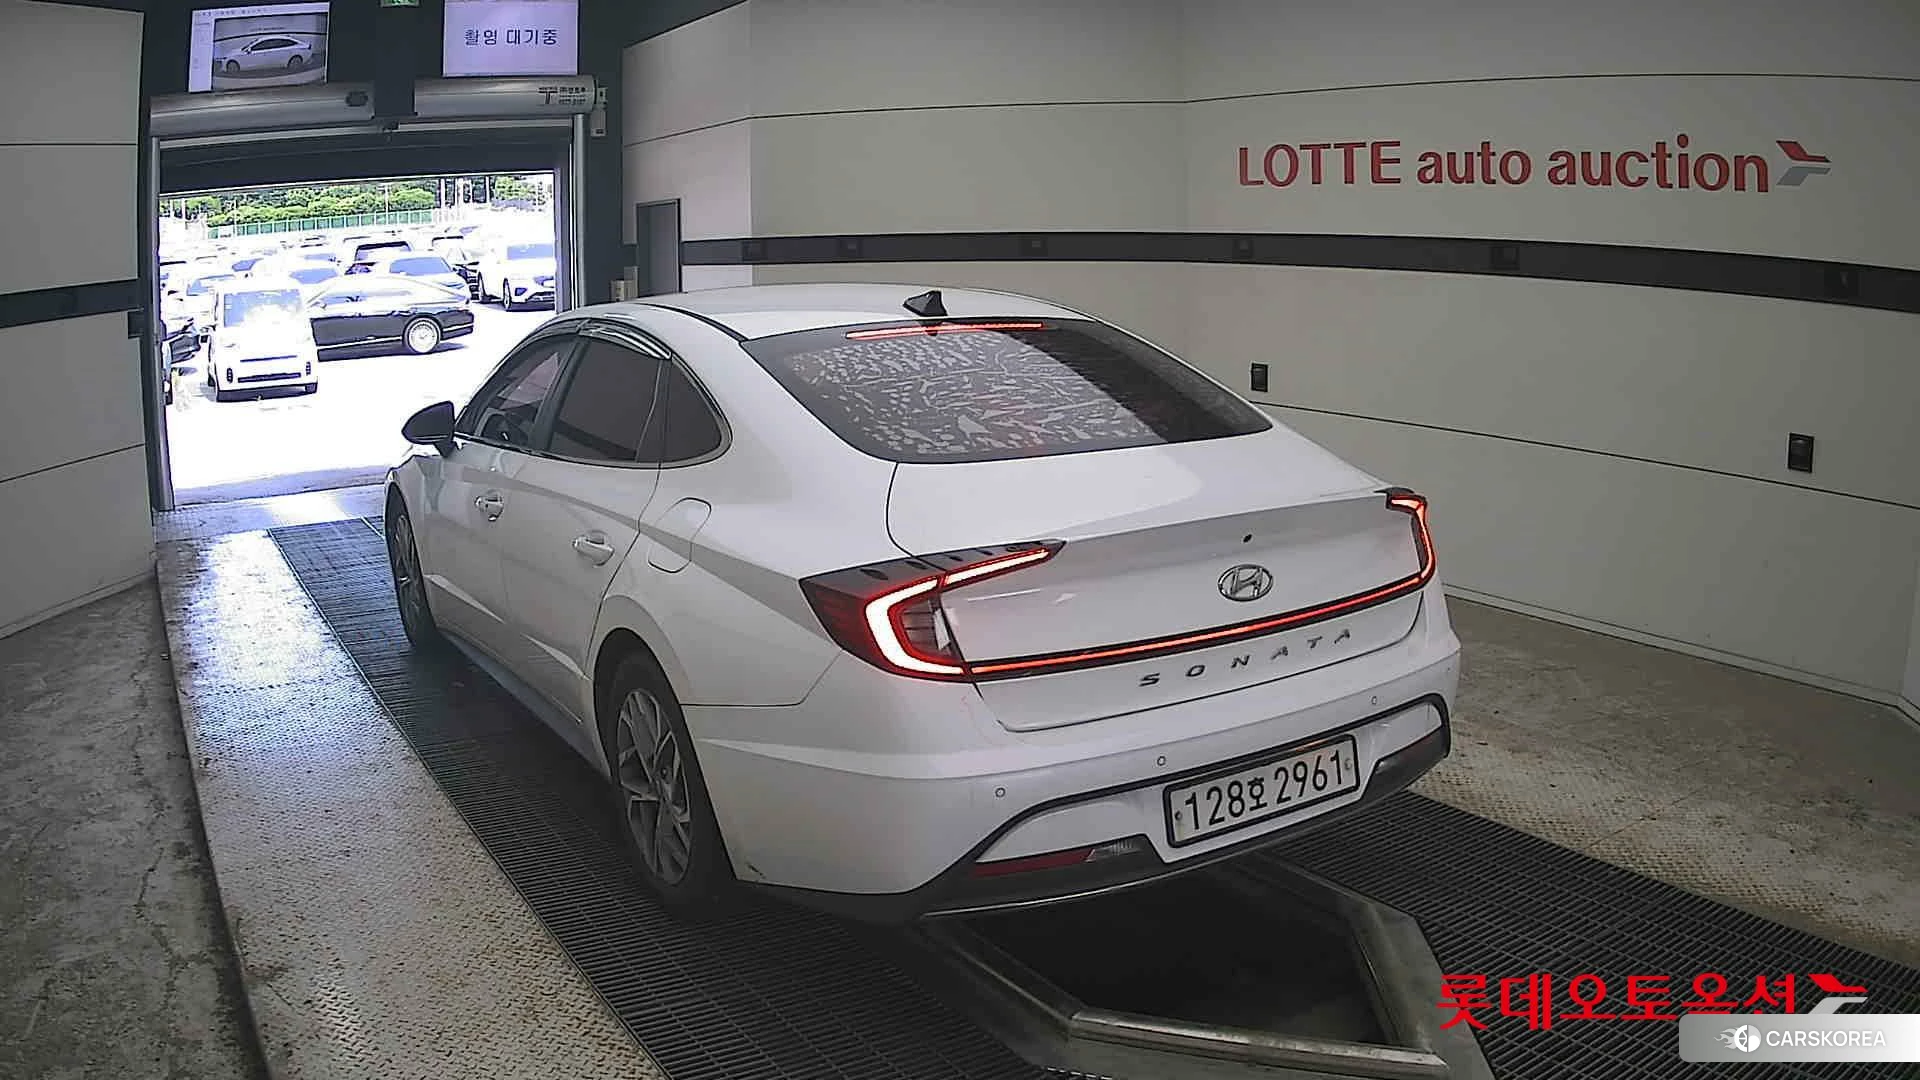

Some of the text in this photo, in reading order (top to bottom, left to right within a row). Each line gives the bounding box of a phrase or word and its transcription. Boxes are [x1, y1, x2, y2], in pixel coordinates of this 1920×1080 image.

[465, 29, 558, 46] 촬영 대기중
[1239, 133, 1769, 193] LOTTE auto auction
[1139, 628, 1351, 687] SONATA
[1185, 749, 1342, 831] 128호 2961
